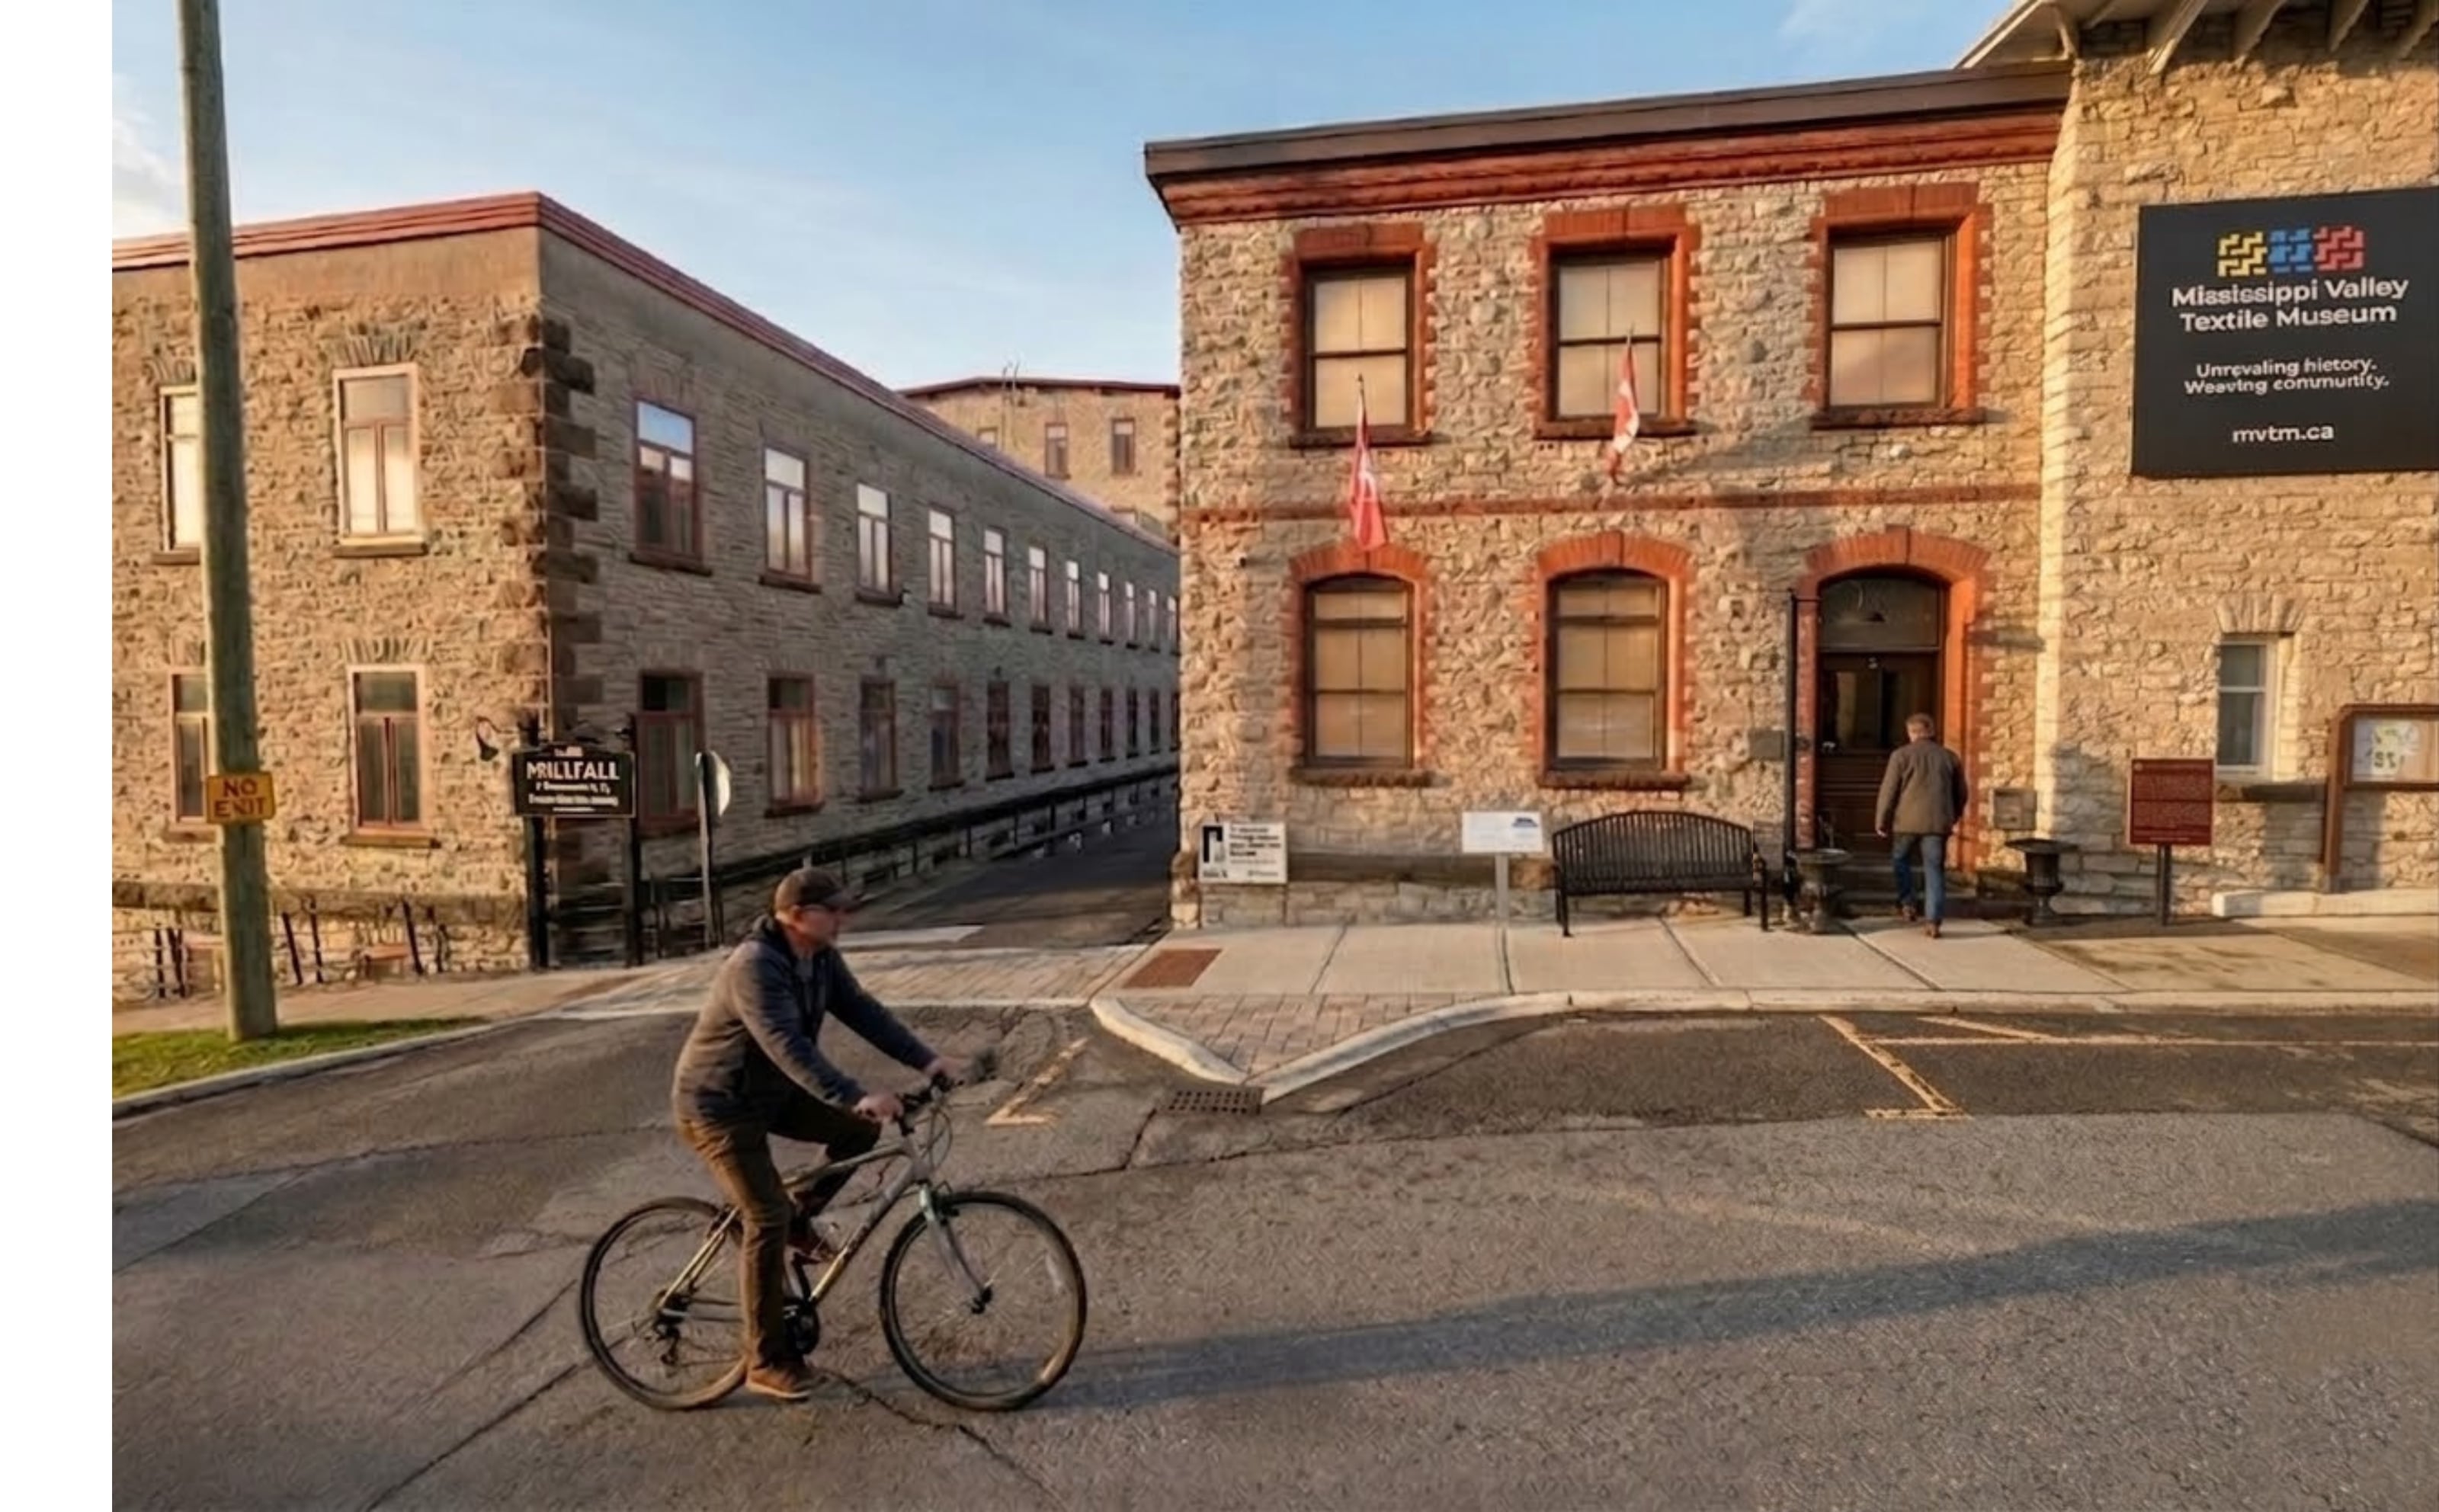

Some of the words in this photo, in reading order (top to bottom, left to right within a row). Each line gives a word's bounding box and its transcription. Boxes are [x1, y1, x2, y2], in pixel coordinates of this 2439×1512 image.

[2172, 279, 2318, 307] Mississippi
[2325, 277, 2409, 299] Valley
[2180, 309, 2269, 332] Textile
[2276, 305, 2397, 328] Museum
[2232, 424, 2334, 443] mvtm.ca
[223, 777, 258, 797] NO
